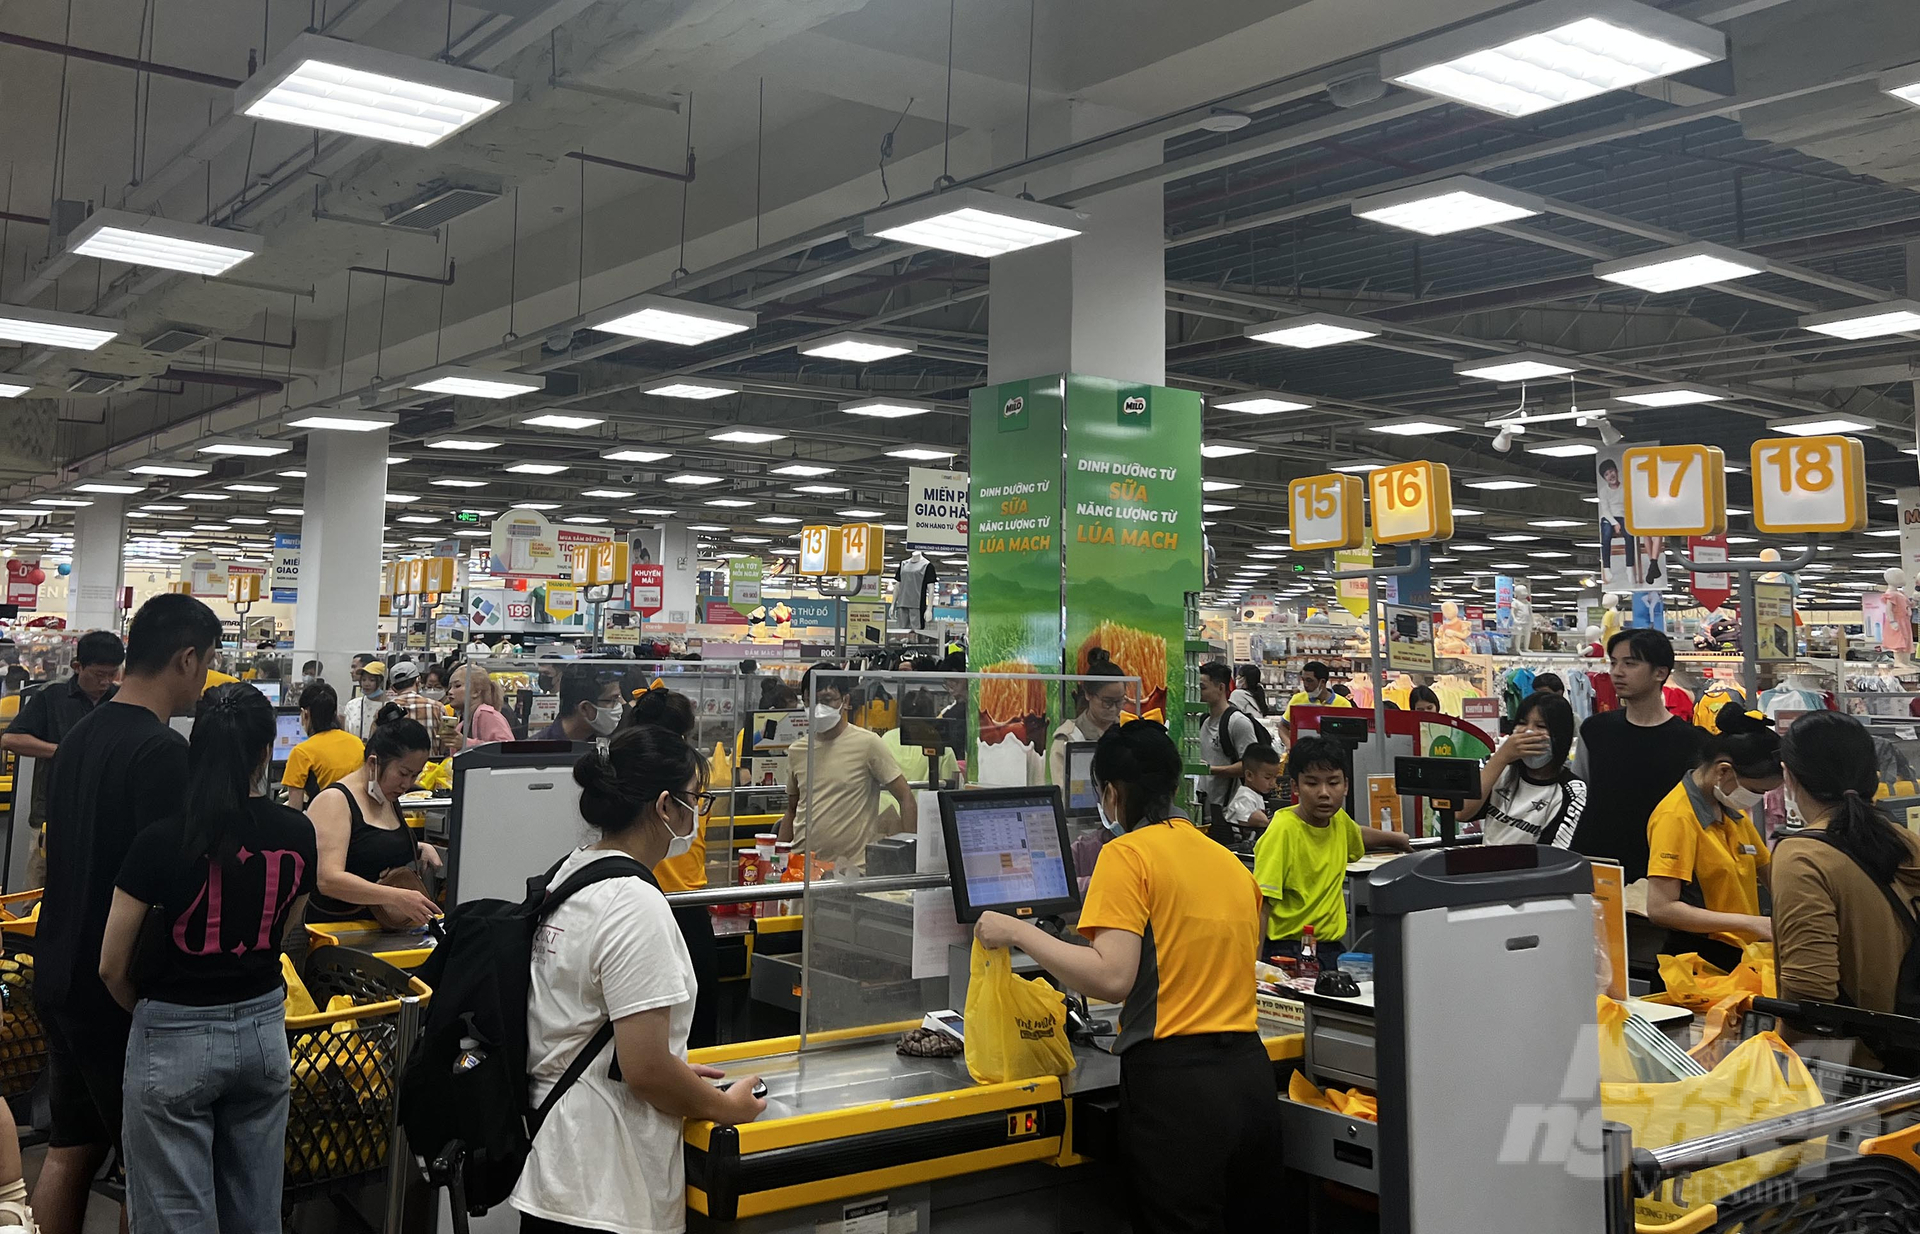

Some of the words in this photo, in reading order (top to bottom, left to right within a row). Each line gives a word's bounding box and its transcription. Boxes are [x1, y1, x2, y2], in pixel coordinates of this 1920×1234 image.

[1126, 402, 1144, 410] MILO
[1078, 459, 1109, 474] DINH
[1112, 460, 1157, 479] DƯỠNG
[1160, 466, 1177, 481] TỪ
[1636, 451, 1695, 499] 17
[1766, 442, 1835, 493] 18
[924, 486, 954, 502] MIỄN
[980, 486, 1001, 497] DINH
[1003, 481, 1035, 495] DƯỠNG
[1037, 480, 1050, 492] TỪ
[1109, 479, 1148, 502] SỮA
[1378, 467, 1423, 510] 16
[915, 503, 947, 517] GIAO
[1001, 496, 1029, 515] SỮA
[1297, 480, 1337, 521] 15
[1076, 501, 1114, 517] NĂNG
[1115, 505, 1158, 523] LƯỢNG
[1160, 509, 1178, 524] TỪ
[979, 519, 1003, 533] NĂNG
[1005, 518, 1035, 532] LƯỢNG
[1037, 516, 1050, 528] TỪ
[804, 530, 822, 554] 13
[843, 528, 864, 554] 14
[979, 535, 1005, 553] LÚA
[1008, 535, 1050, 555] MẠCH
[1076, 521, 1115, 545] LÚA
[1121, 529, 1178, 552] MẠCH
[574, 548, 585, 569] 11
[598, 545, 611, 567] 12
[634, 568, 661, 578] KHUYẾN
[229, 577, 235, 591] 5
[242, 577, 248, 590] 6
[508, 604, 531, 617] 199
[798, 606, 816, 616] THỬ
[816, 606, 829, 616] ĐỒ
